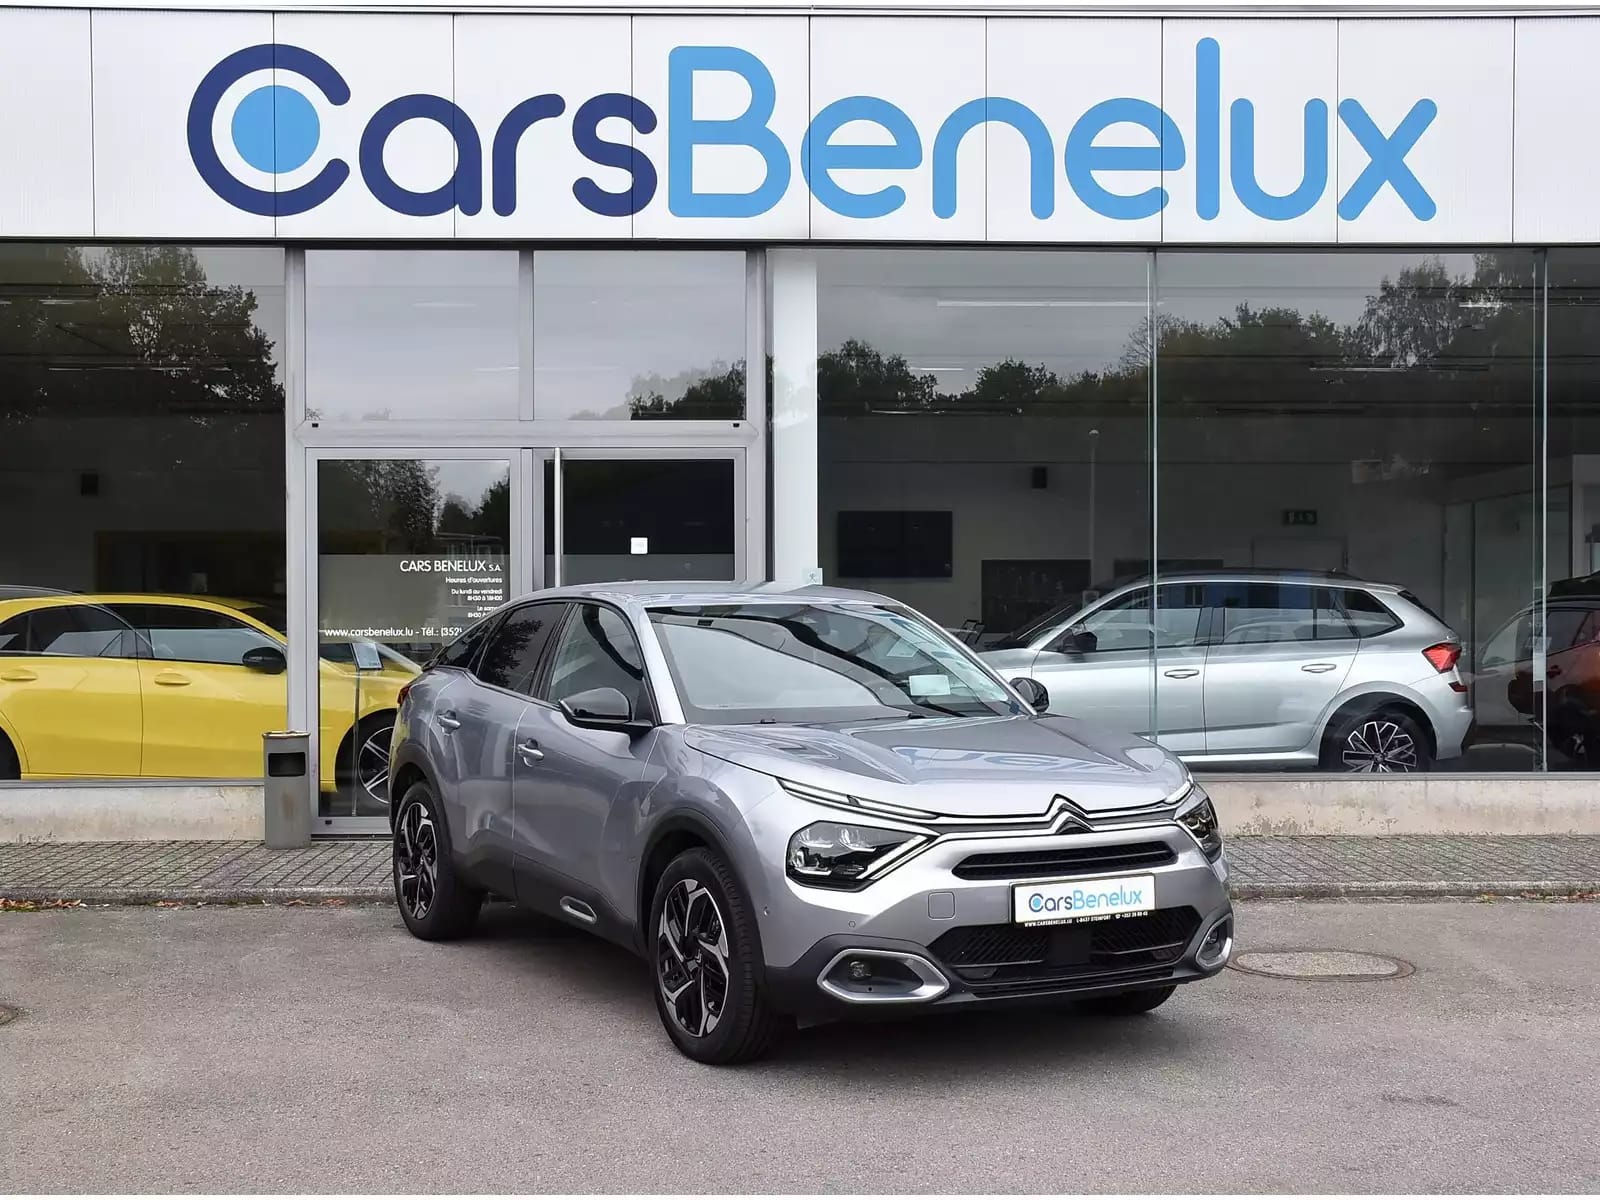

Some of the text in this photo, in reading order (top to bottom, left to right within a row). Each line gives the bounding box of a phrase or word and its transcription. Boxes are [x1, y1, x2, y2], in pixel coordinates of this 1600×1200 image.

[187, 37, 1437, 221] CarsBenelux
[399, 560, 503, 572] CARS BENELUX S.A.
[445, 576, 503, 584] Heures d'ouvertures
[325, 627, 414, 637] www.carsbenelux.lu
[421, 627, 439, 637] Tél.:
[1028, 884, 1143, 913] CarsBenelux
